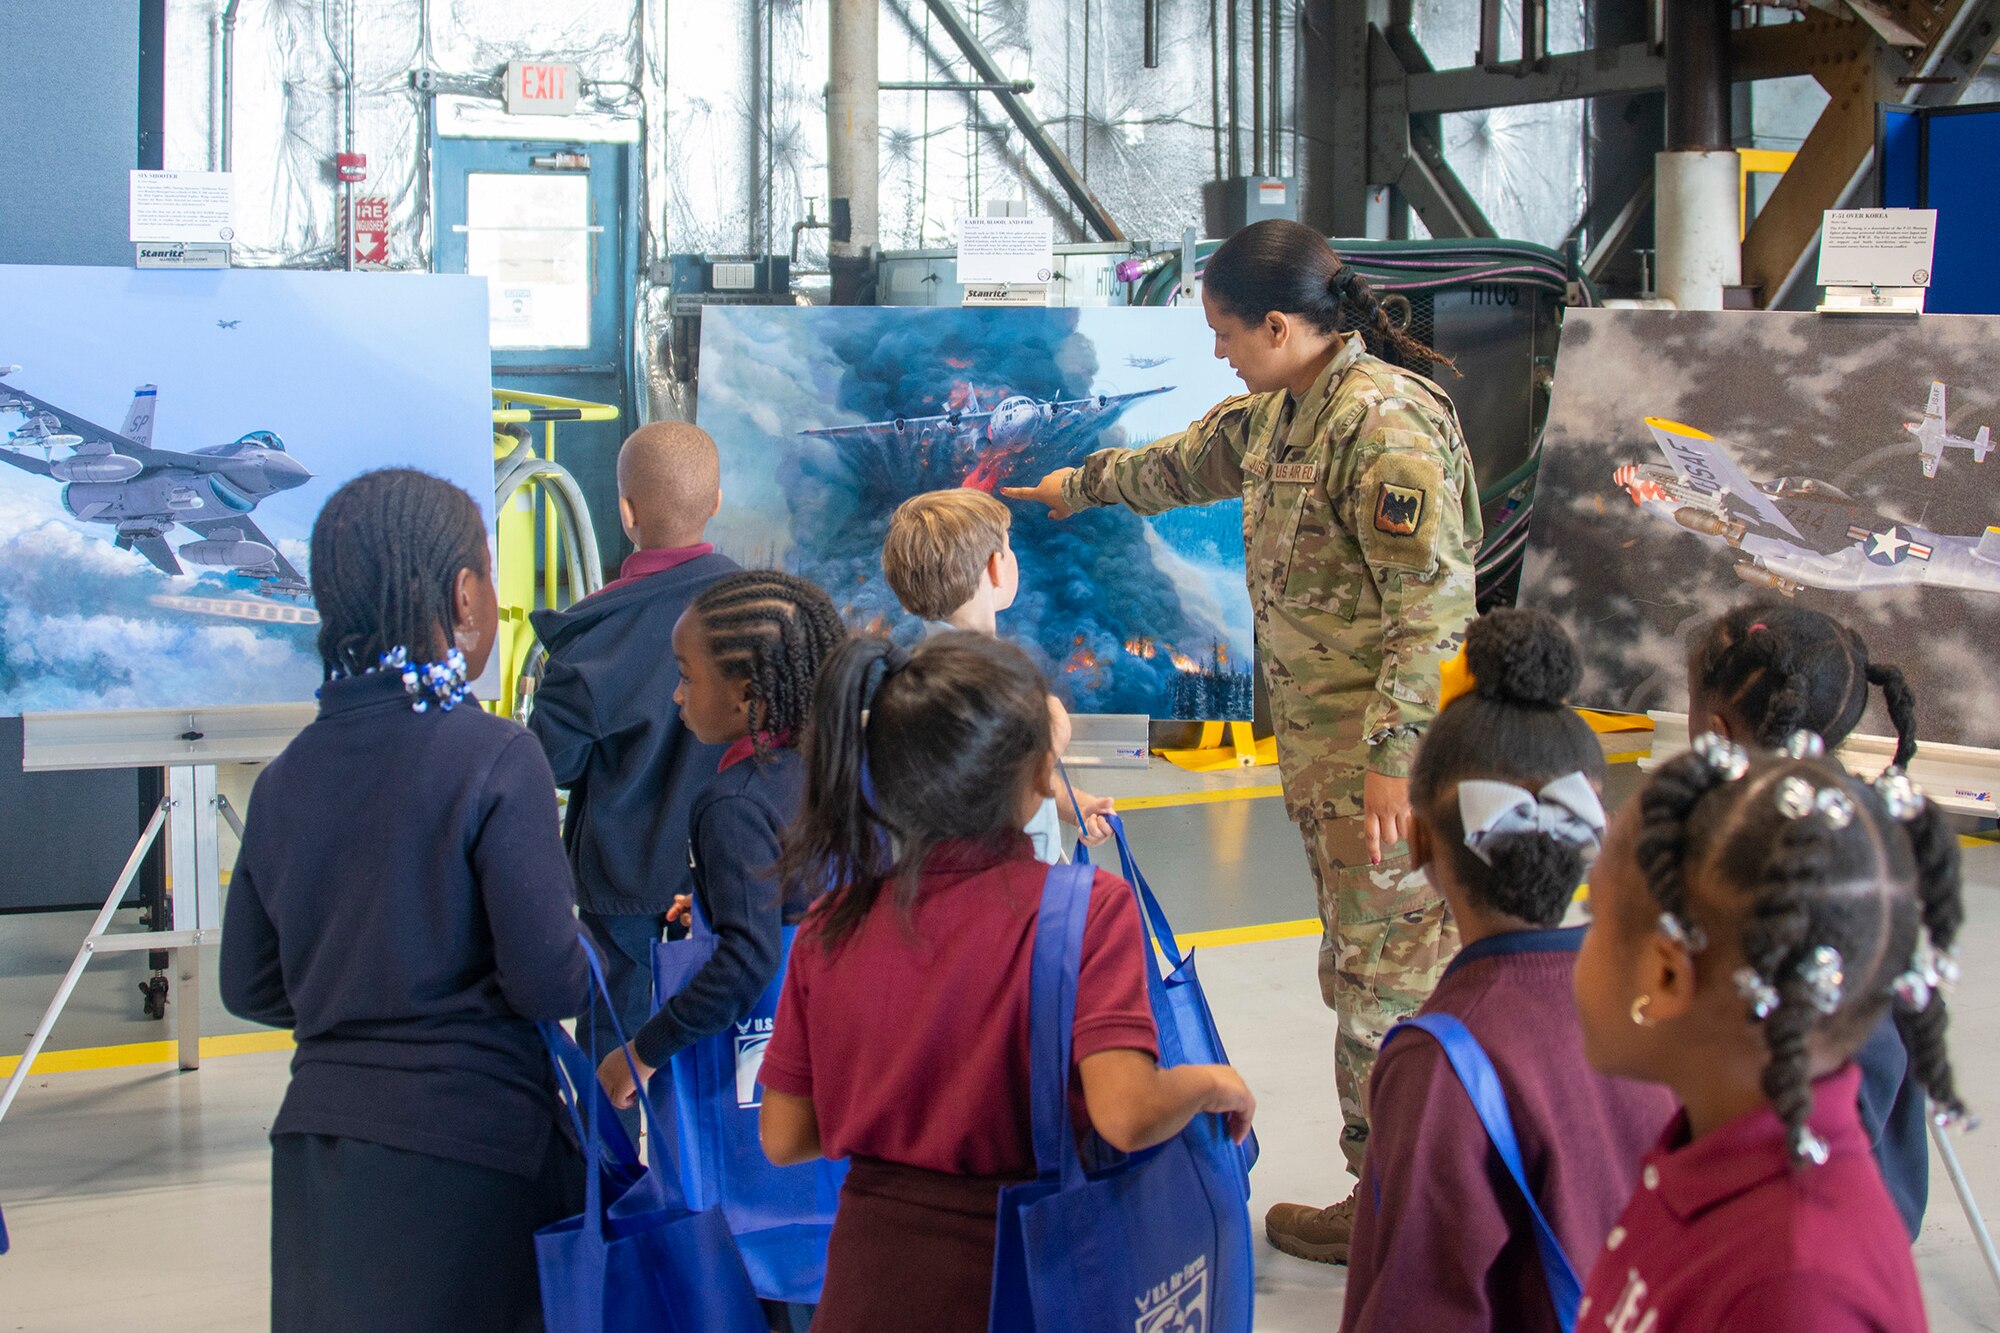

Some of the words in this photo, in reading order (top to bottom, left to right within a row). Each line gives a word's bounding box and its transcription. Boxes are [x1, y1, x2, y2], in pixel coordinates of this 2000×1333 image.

[522, 65, 568, 99] EXIT
[356, 205, 384, 218] IRE
[140, 249, 185, 258] Stanrite
[967, 289, 1008, 298] Stanrite
[129, 415, 150, 433] SP
[1275, 465, 1288, 478] US
